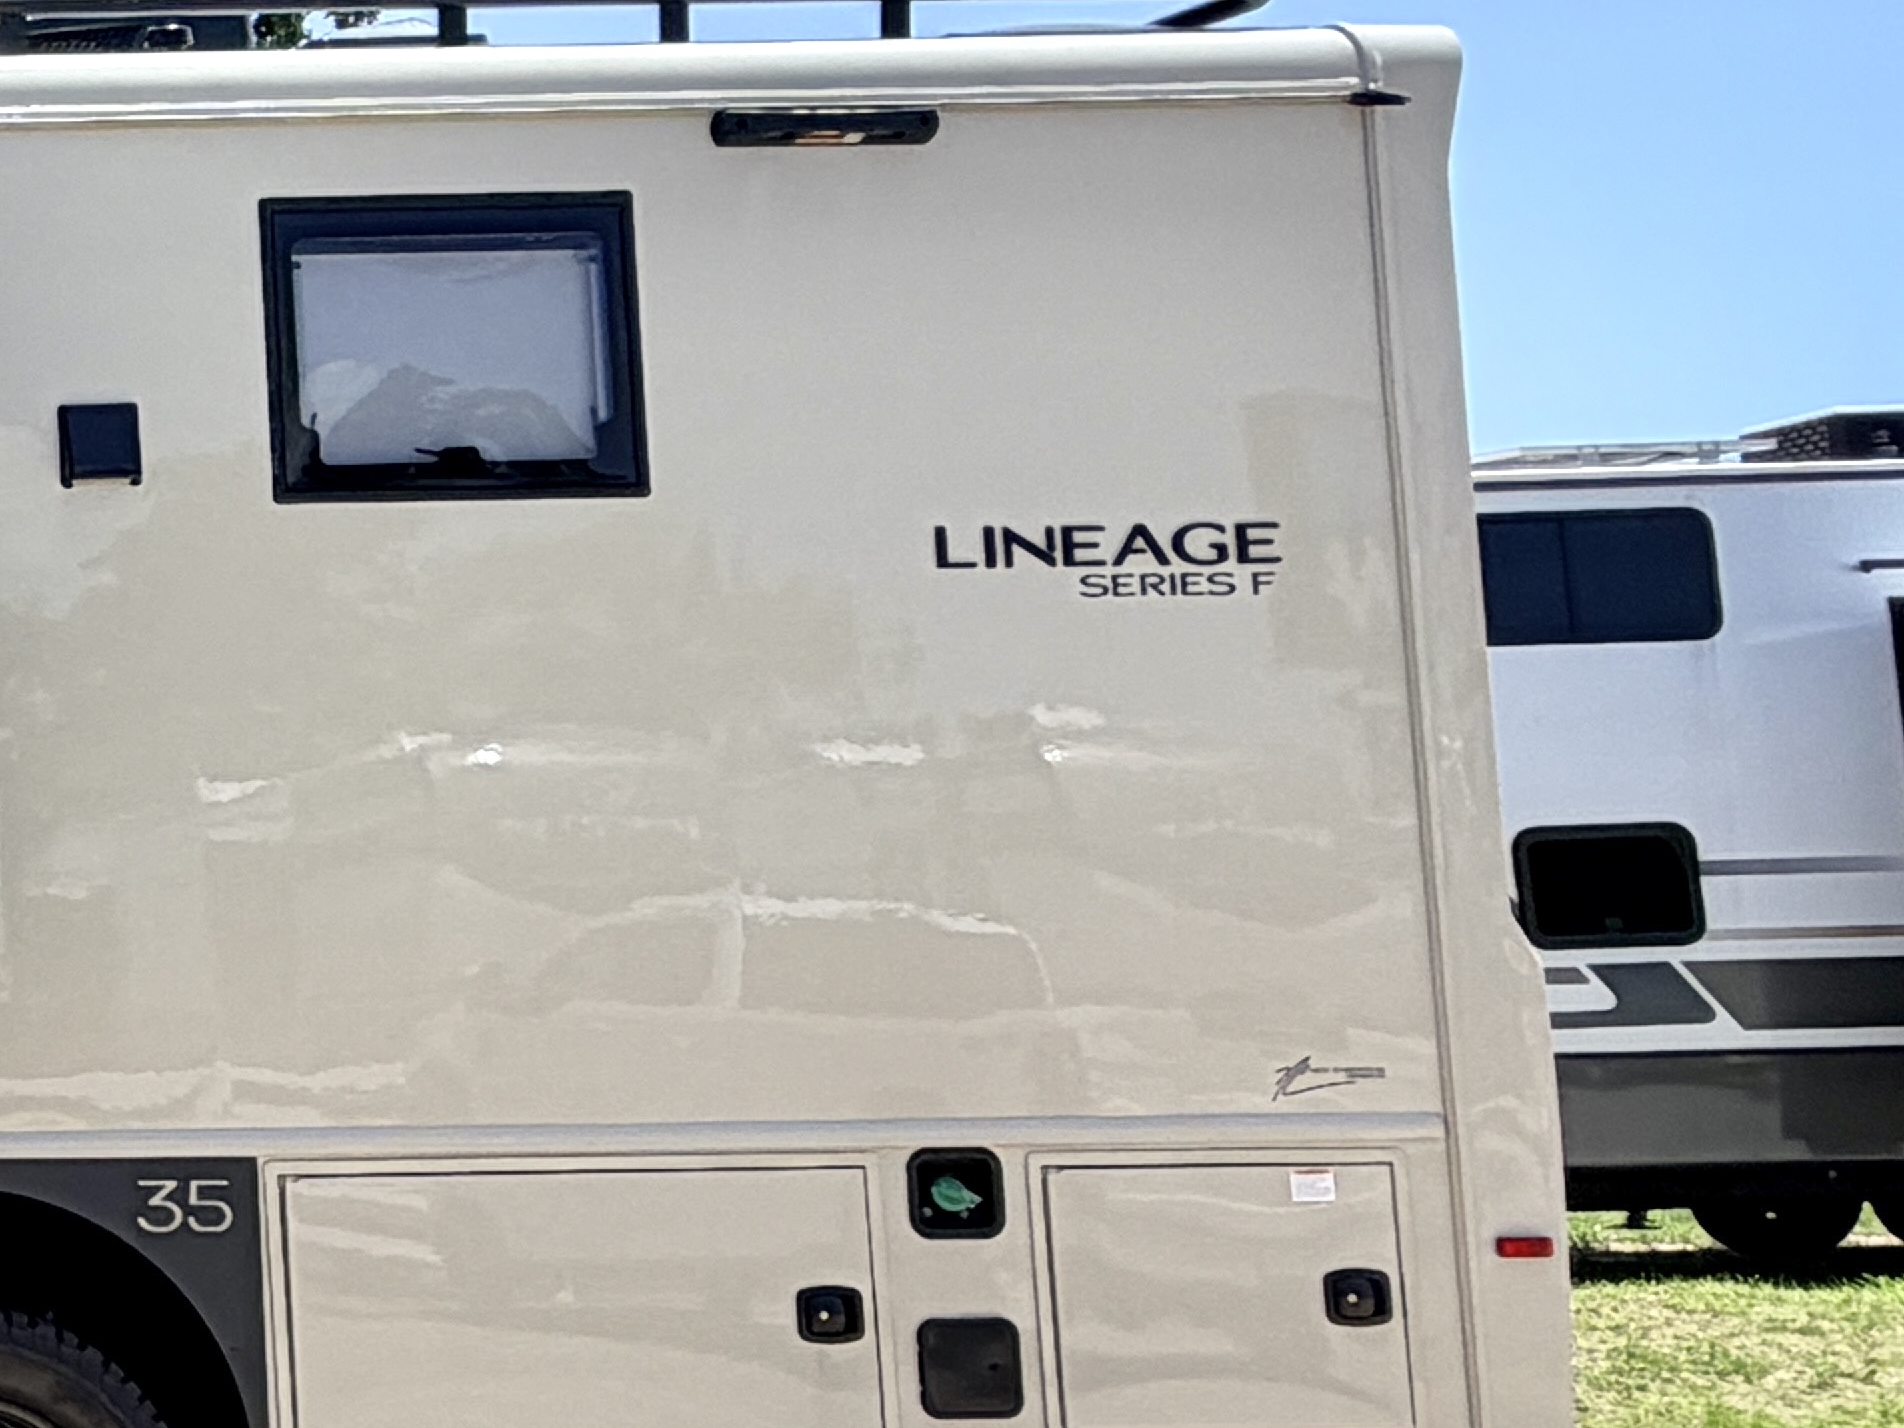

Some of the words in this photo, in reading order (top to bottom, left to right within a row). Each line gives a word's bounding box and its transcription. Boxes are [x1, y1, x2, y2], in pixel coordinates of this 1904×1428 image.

[934, 522, 1283, 569] LINEAGE
[1078, 572, 1236, 598] SERIES
[1251, 572, 1276, 596] F
[136, 1179, 234, 1233] 35
